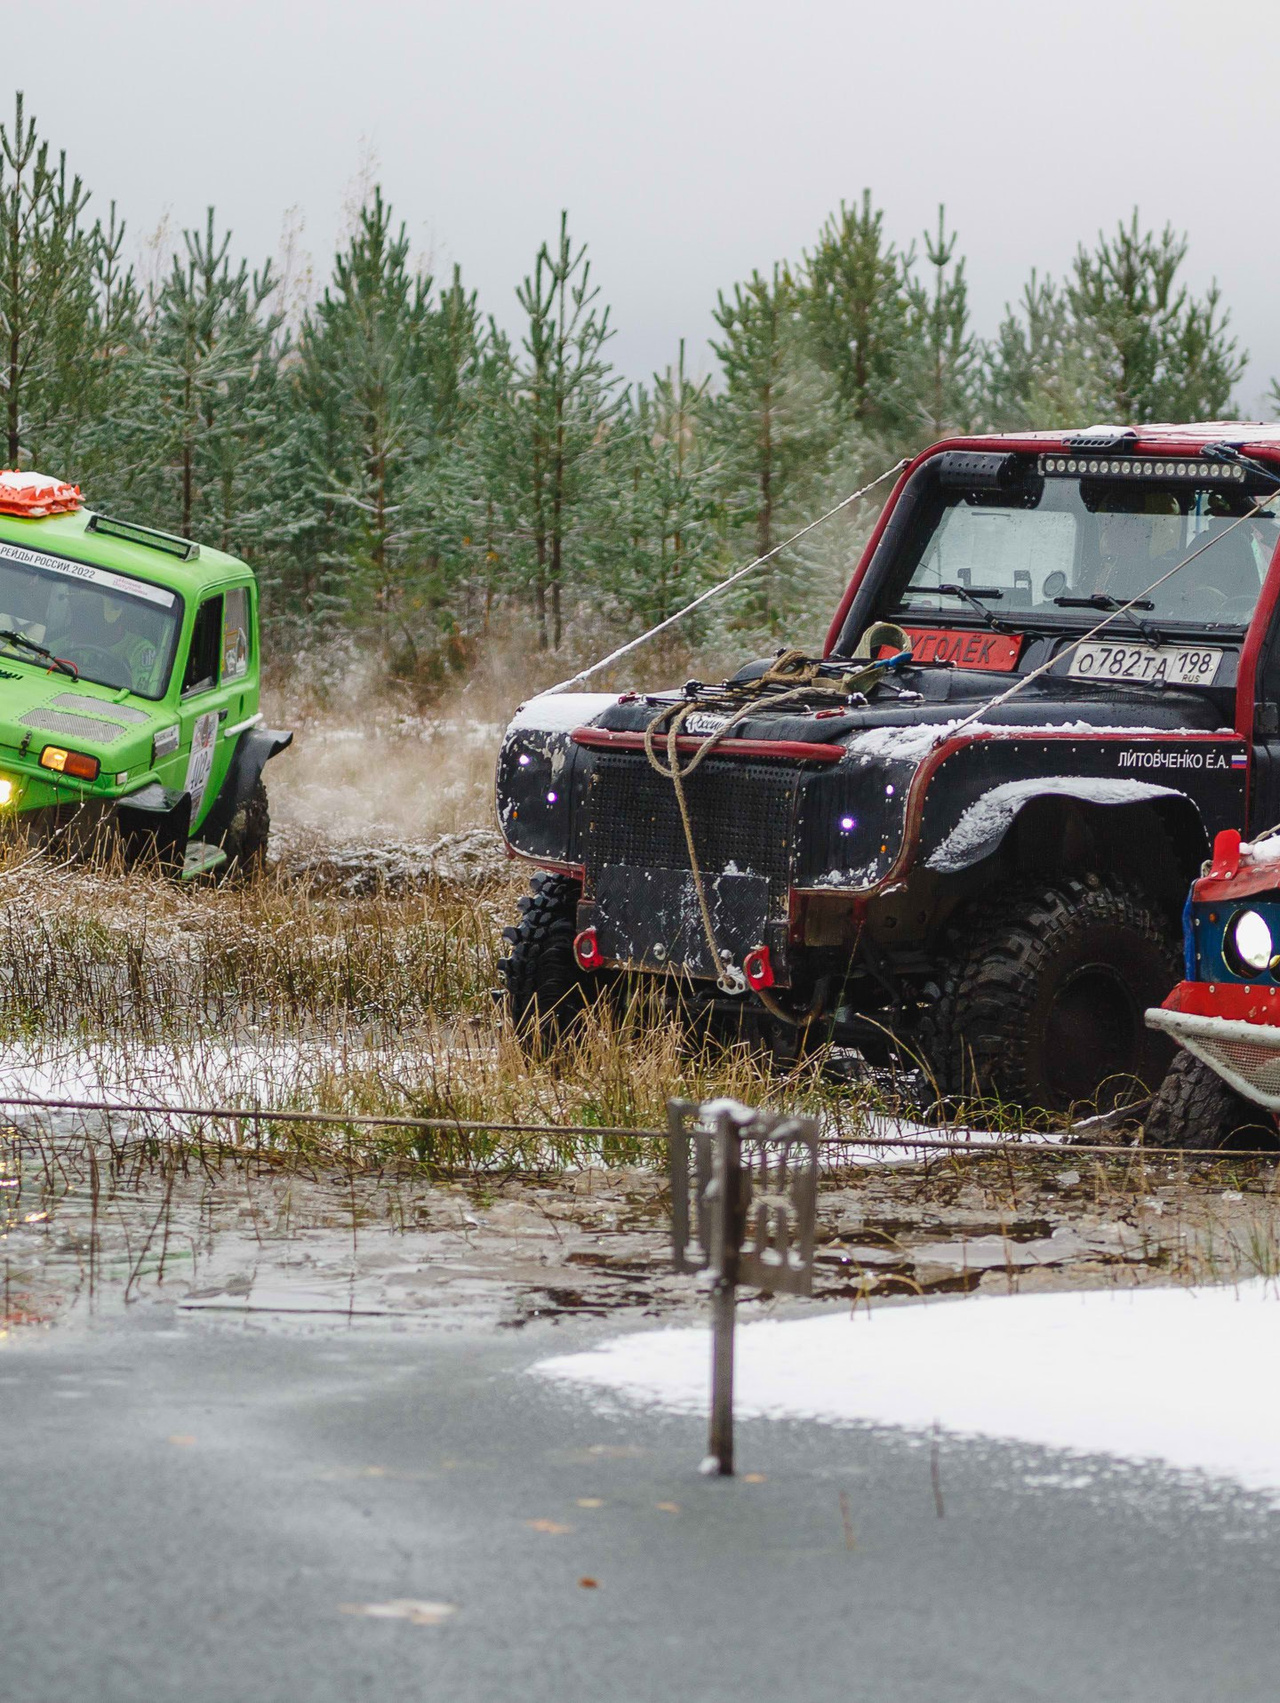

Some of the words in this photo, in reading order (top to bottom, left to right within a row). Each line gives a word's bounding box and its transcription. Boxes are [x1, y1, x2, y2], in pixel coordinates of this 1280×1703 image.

[1178, 652, 1212, 674] 198
[1182, 674, 1201, 683] RUS
[1118, 752, 1203, 768] ЛИТОВЧЕНКО
[1206, 754, 1229, 769] Е.А.
